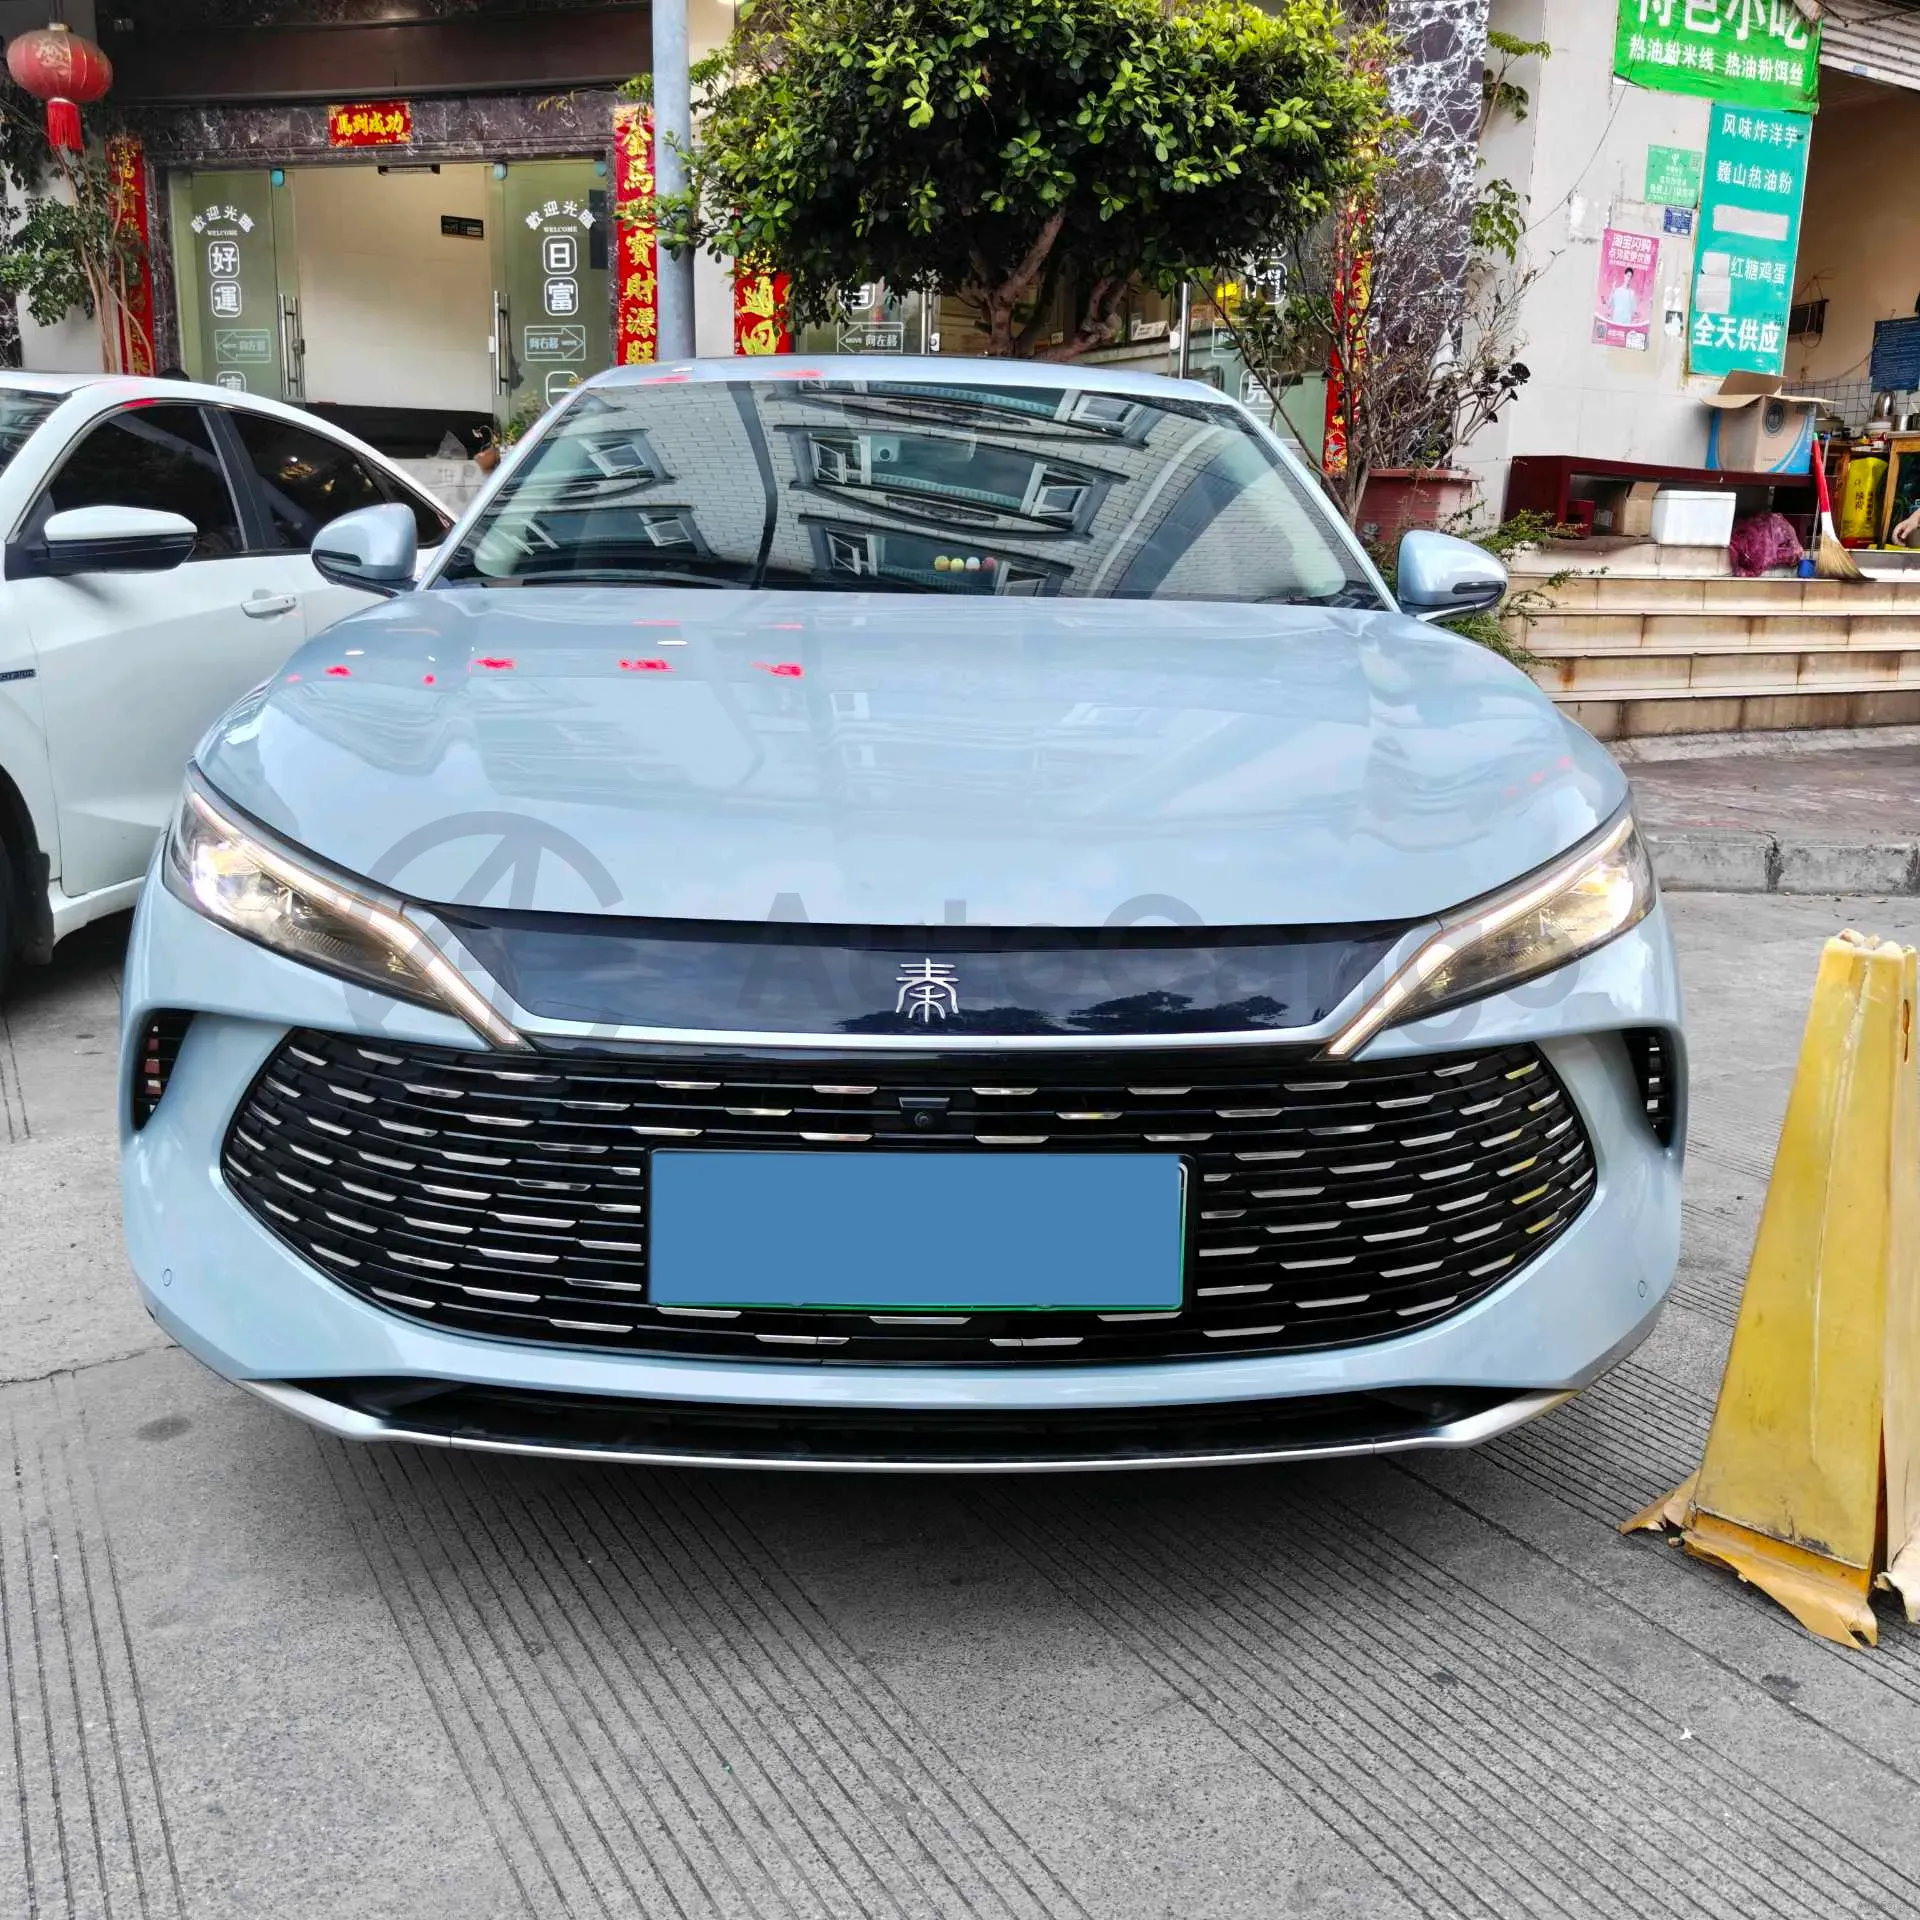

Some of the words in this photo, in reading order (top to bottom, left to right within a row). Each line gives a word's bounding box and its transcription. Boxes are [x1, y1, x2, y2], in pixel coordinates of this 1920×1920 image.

[1629, 34, 1714, 73] 热油粉米线
[1725, 52, 1804, 87] 热油粉饵丝
[337, 110, 405, 136] 馬到成功
[1722, 113, 1798, 149] 风味炸洋芋
[1716, 160, 1793, 195] 巍山热油粉
[191, 205, 256, 234] 歡迎光臨
[525, 200, 597, 231] 歡迎光臨
[1730, 255, 1787, 285] 红糖鸡蛋
[1692, 313, 1781, 353] 全天供应
[894, 957, 960, 1023] 秦
